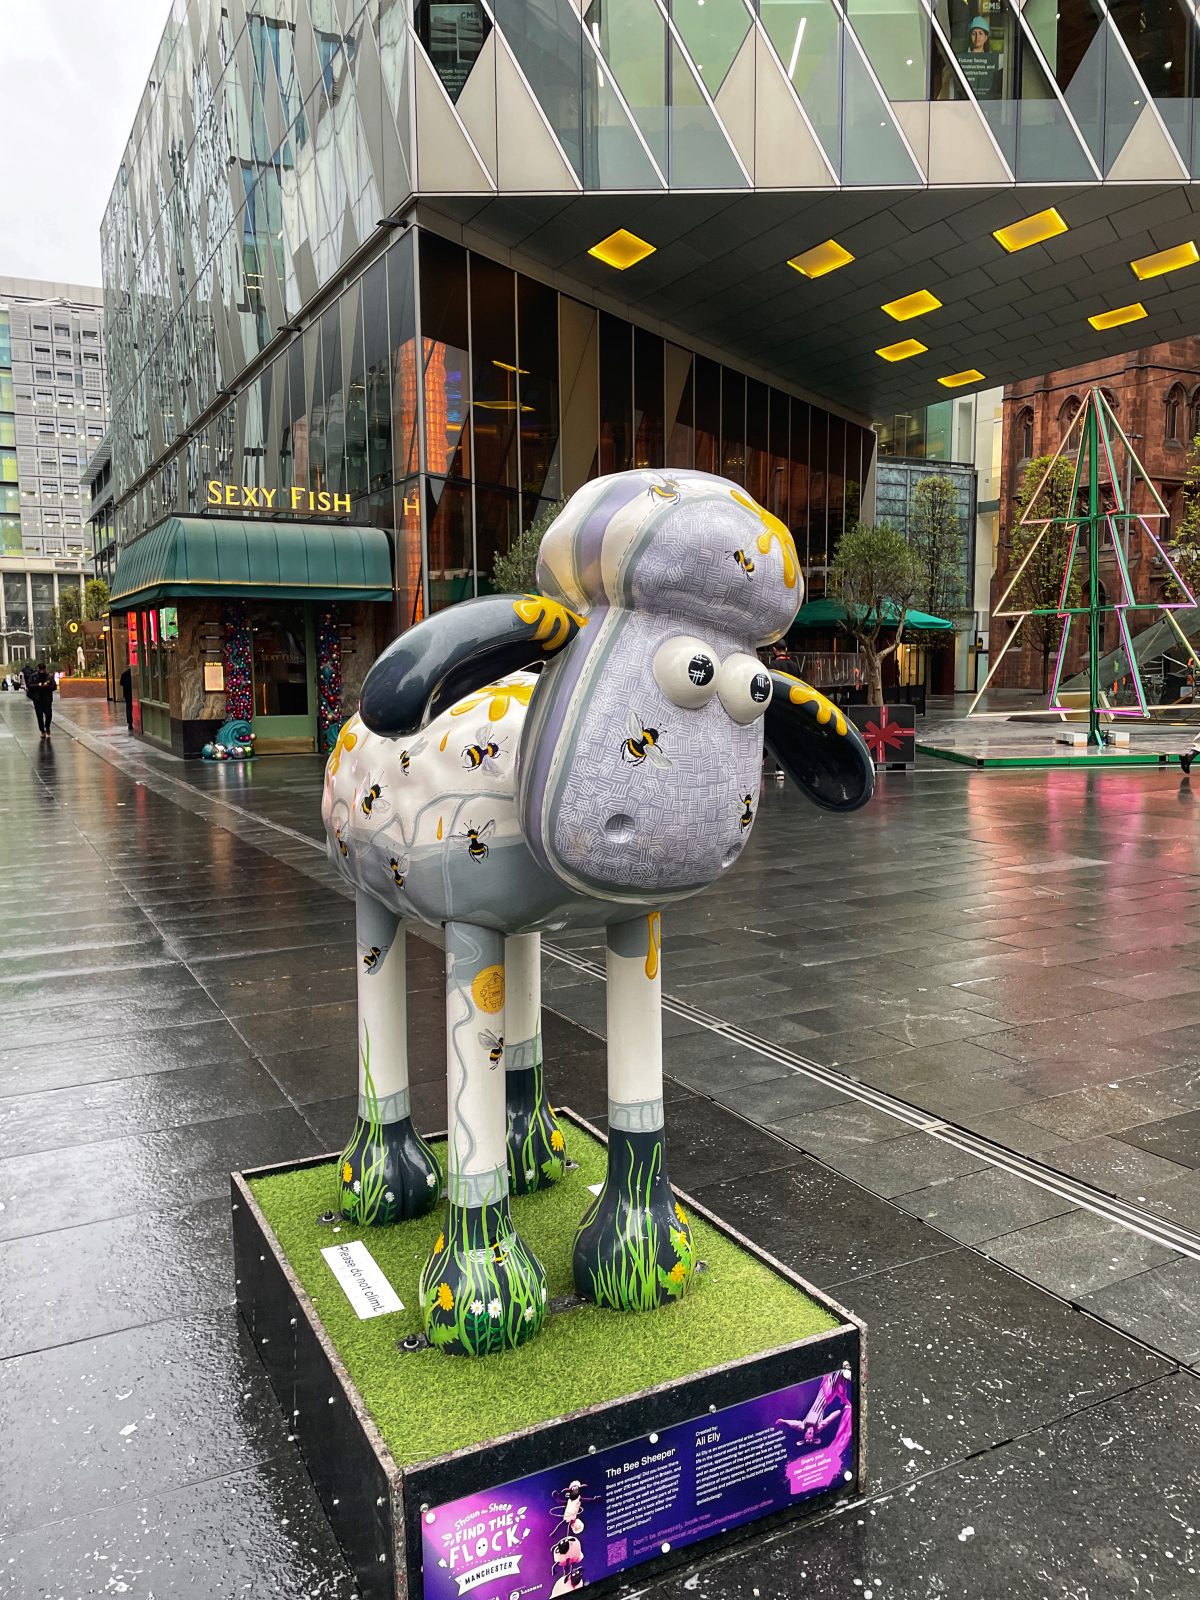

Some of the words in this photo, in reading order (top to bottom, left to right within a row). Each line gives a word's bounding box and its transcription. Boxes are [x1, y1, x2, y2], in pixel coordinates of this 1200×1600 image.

[207, 480, 277, 507] SEXY
[291, 487, 351, 513] FISH
[337, 1246, 356, 1267] Please
[351, 1268, 363, 1277] do
[356, 1278, 372, 1290] not
[696, 1436, 706, 1447] Ali
[707, 1432, 721, 1443] Elly
[605, 1467, 621, 1478] The
[623, 1461, 640, 1472] Bee
[641, 1448, 676, 1466] Sheeper
[454, 1510, 480, 1530] Shaun
[488, 1503, 513, 1513] Sheep
[455, 1522, 486, 1543] FIND
[488, 1513, 514, 1531] THE
[449, 1523, 520, 1568] FLOCK
[464, 1561, 513, 1584] MANCHESTER
